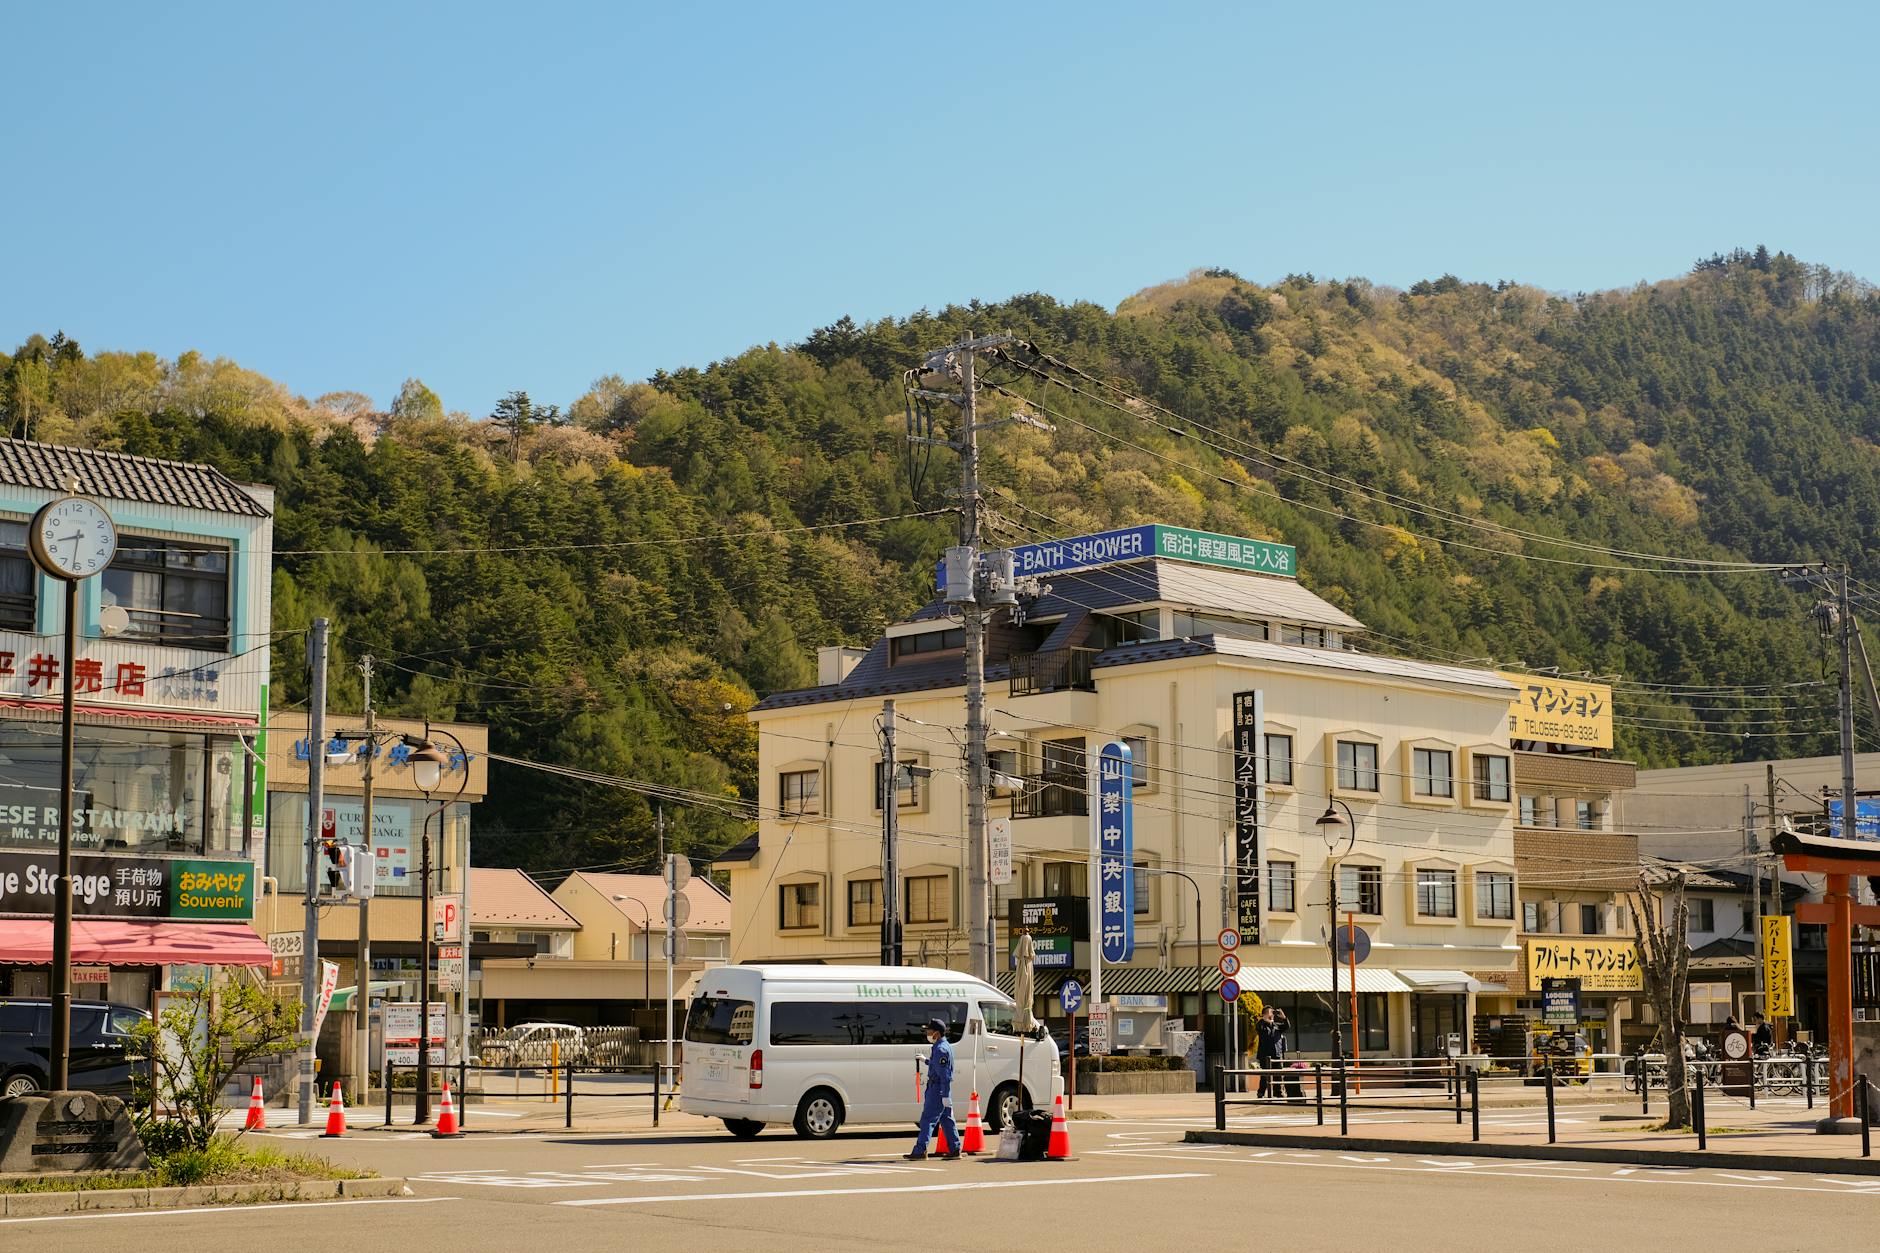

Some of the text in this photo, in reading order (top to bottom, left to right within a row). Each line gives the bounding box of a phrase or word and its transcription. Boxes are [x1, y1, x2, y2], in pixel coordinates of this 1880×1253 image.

[58, 507, 68, 516] 11
[72, 504, 83, 512] 12
[49, 518, 60, 526] 10
[45, 531, 54, 539] 9
[101, 535, 109, 543] 3
[49, 544, 58, 553] 8
[1023, 546, 1064, 571] BATH
[1071, 532, 1142, 562] SHOWER
[1162, 532, 1289, 571] 宿泊・展望風呂・入浴
[60, 557, 68, 565] 7
[73, 562, 82, 571] 6
[88, 559, 96, 567] 5
[1527, 685, 1604, 719] マンション
[43, 807, 185, 834] RSTAURANT
[1103, 758, 1124, 948] 山梨中央銀行
[115, 867, 163, 887] 手荷物
[179, 871, 246, 893] おみやげ
[25, 864, 111, 905] Stoage
[115, 888, 162, 907] 預り所
[179, 893, 245, 908] Souvenir
[1240, 899, 1257, 908] CAFE
[445, 904, 456, 932] P
[1022, 907, 1059, 917] STATION
[1022, 916, 1039, 924] INN
[1240, 915, 1257, 924] REST
[270, 936, 302, 954] ほうとう
[1032, 939, 1055, 951] OFFEE
[1223, 934, 1236, 946] 30
[1535, 944, 1637, 971] アパート マンション
[450, 963, 462, 975] 400
[1768, 919, 1781, 1012] アパート マンション
[73, 972, 108, 981] TAX FREE
[856, 984, 967, 999] Hotel Koryu
[1781, 959, 1789, 1012] フジオホーム
[1120, 996, 1144, 1006] BANK
